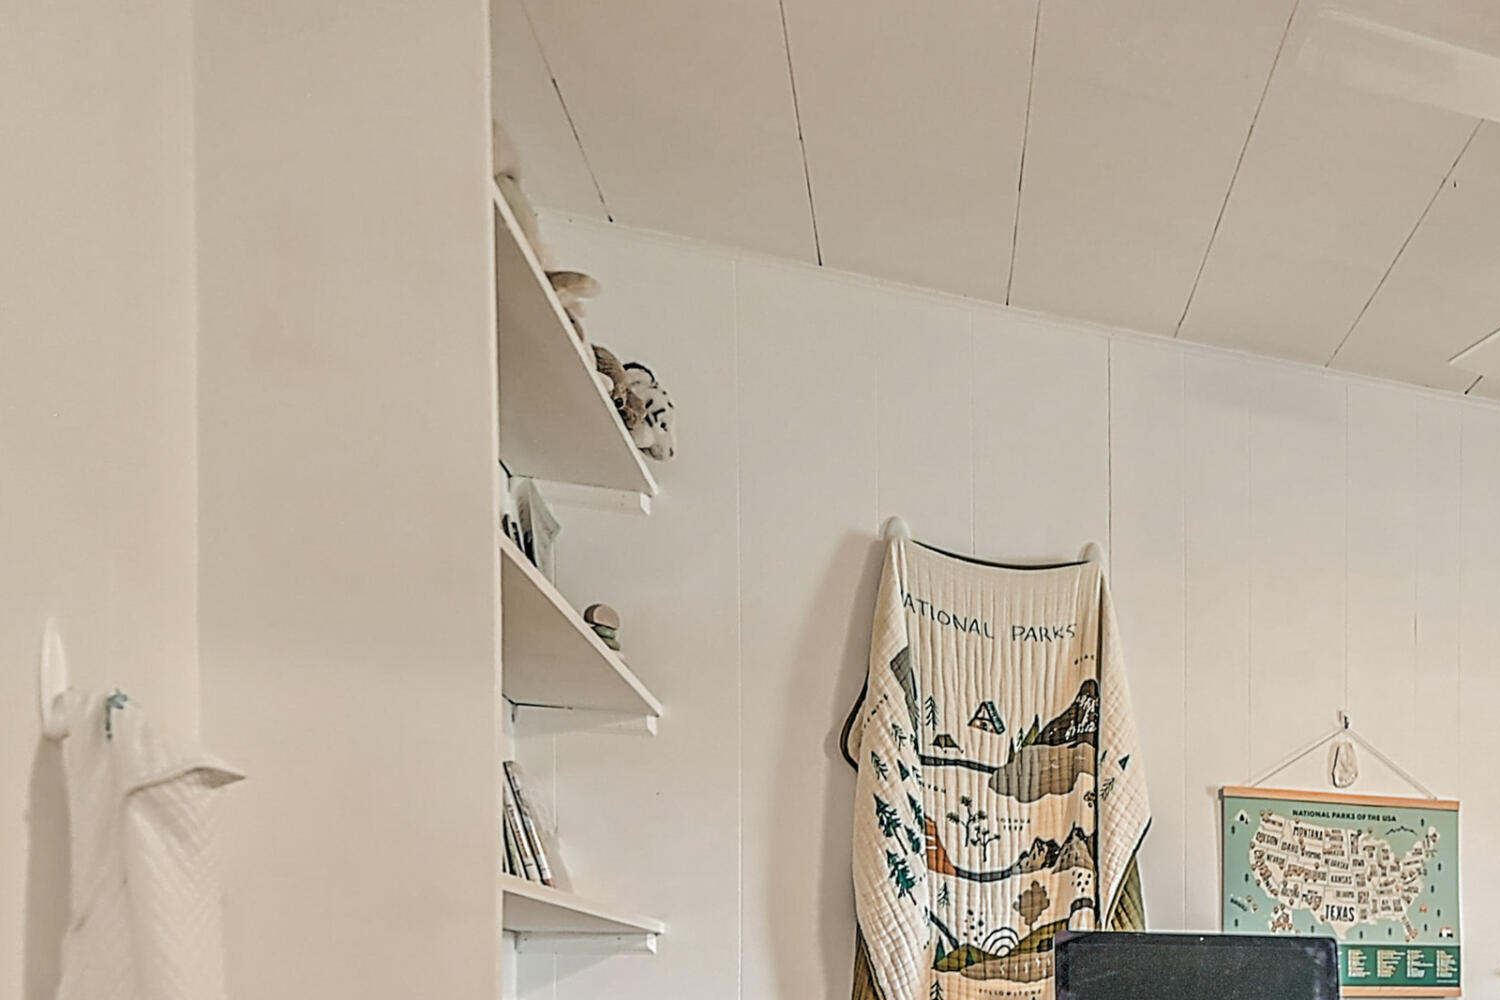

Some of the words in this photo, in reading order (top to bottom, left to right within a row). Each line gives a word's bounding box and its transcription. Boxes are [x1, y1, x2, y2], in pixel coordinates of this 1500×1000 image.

[1011, 624, 1077, 642] PARKS
[1292, 809, 1330, 818] NATIONAL
[1332, 811, 1355, 820] PARKS
[1325, 904, 1355, 922] TEXAS
